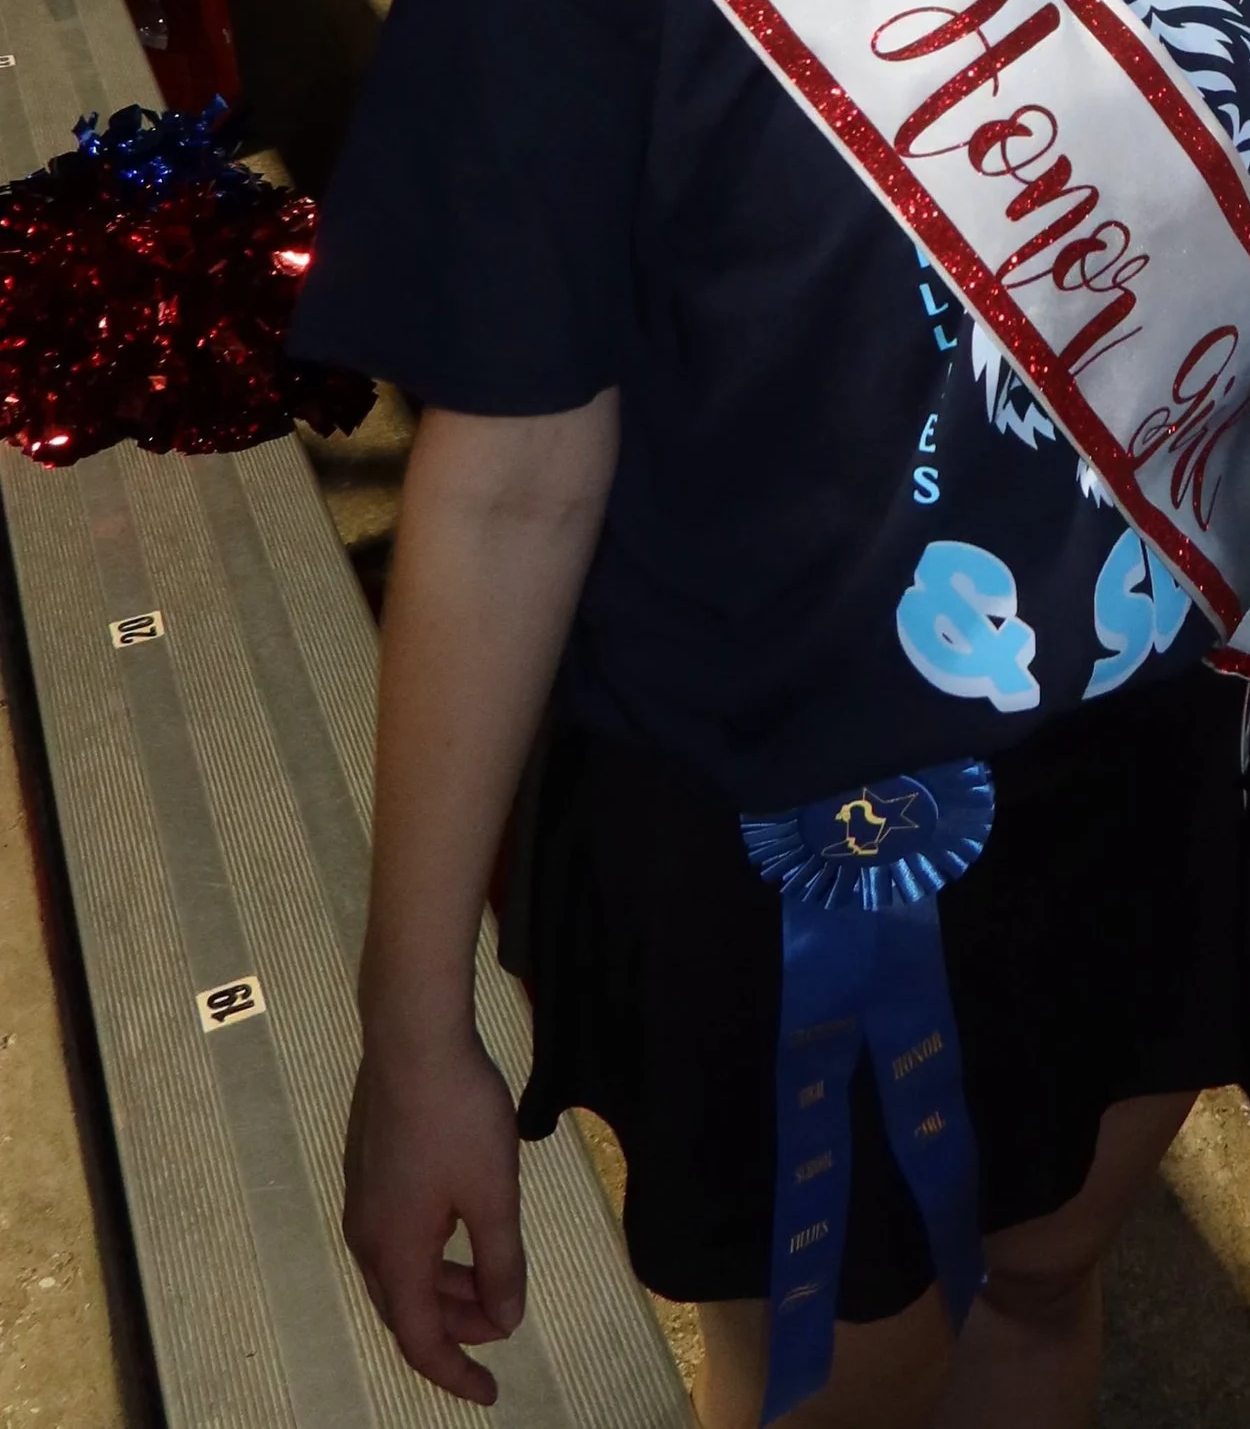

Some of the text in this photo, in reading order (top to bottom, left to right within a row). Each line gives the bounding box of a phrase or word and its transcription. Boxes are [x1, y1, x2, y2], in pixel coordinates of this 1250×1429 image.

[118, 616, 157, 644] 20
[896, 540, 1040, 714] &
[207, 983, 255, 1023] 19
